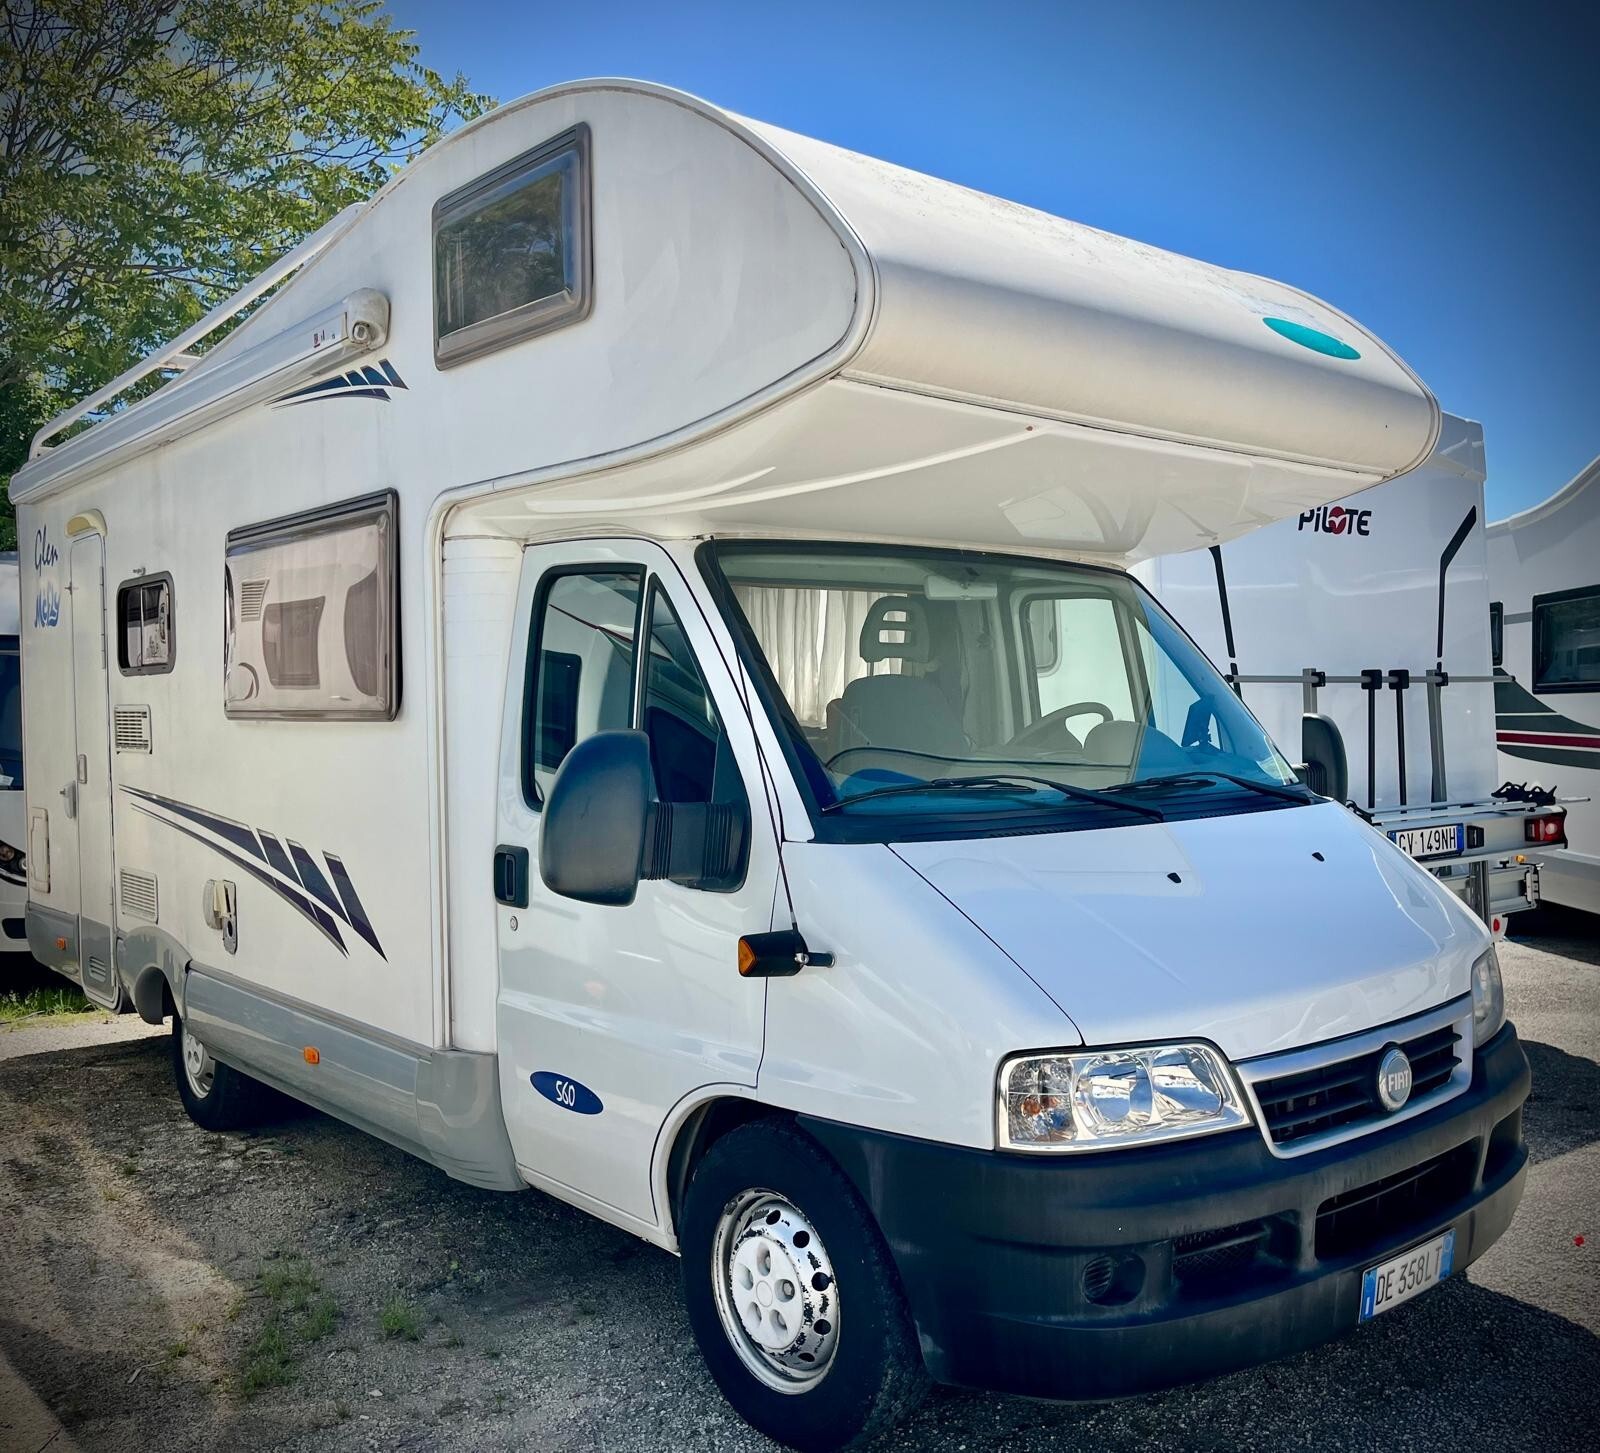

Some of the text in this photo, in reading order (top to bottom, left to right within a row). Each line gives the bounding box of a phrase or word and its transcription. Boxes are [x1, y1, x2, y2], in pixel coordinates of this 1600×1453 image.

[1399, 827, 1457, 855] GV 149NH
[1388, 1069, 1409, 1092] FIAT
[1375, 1246, 1442, 1306] DE 358LT
